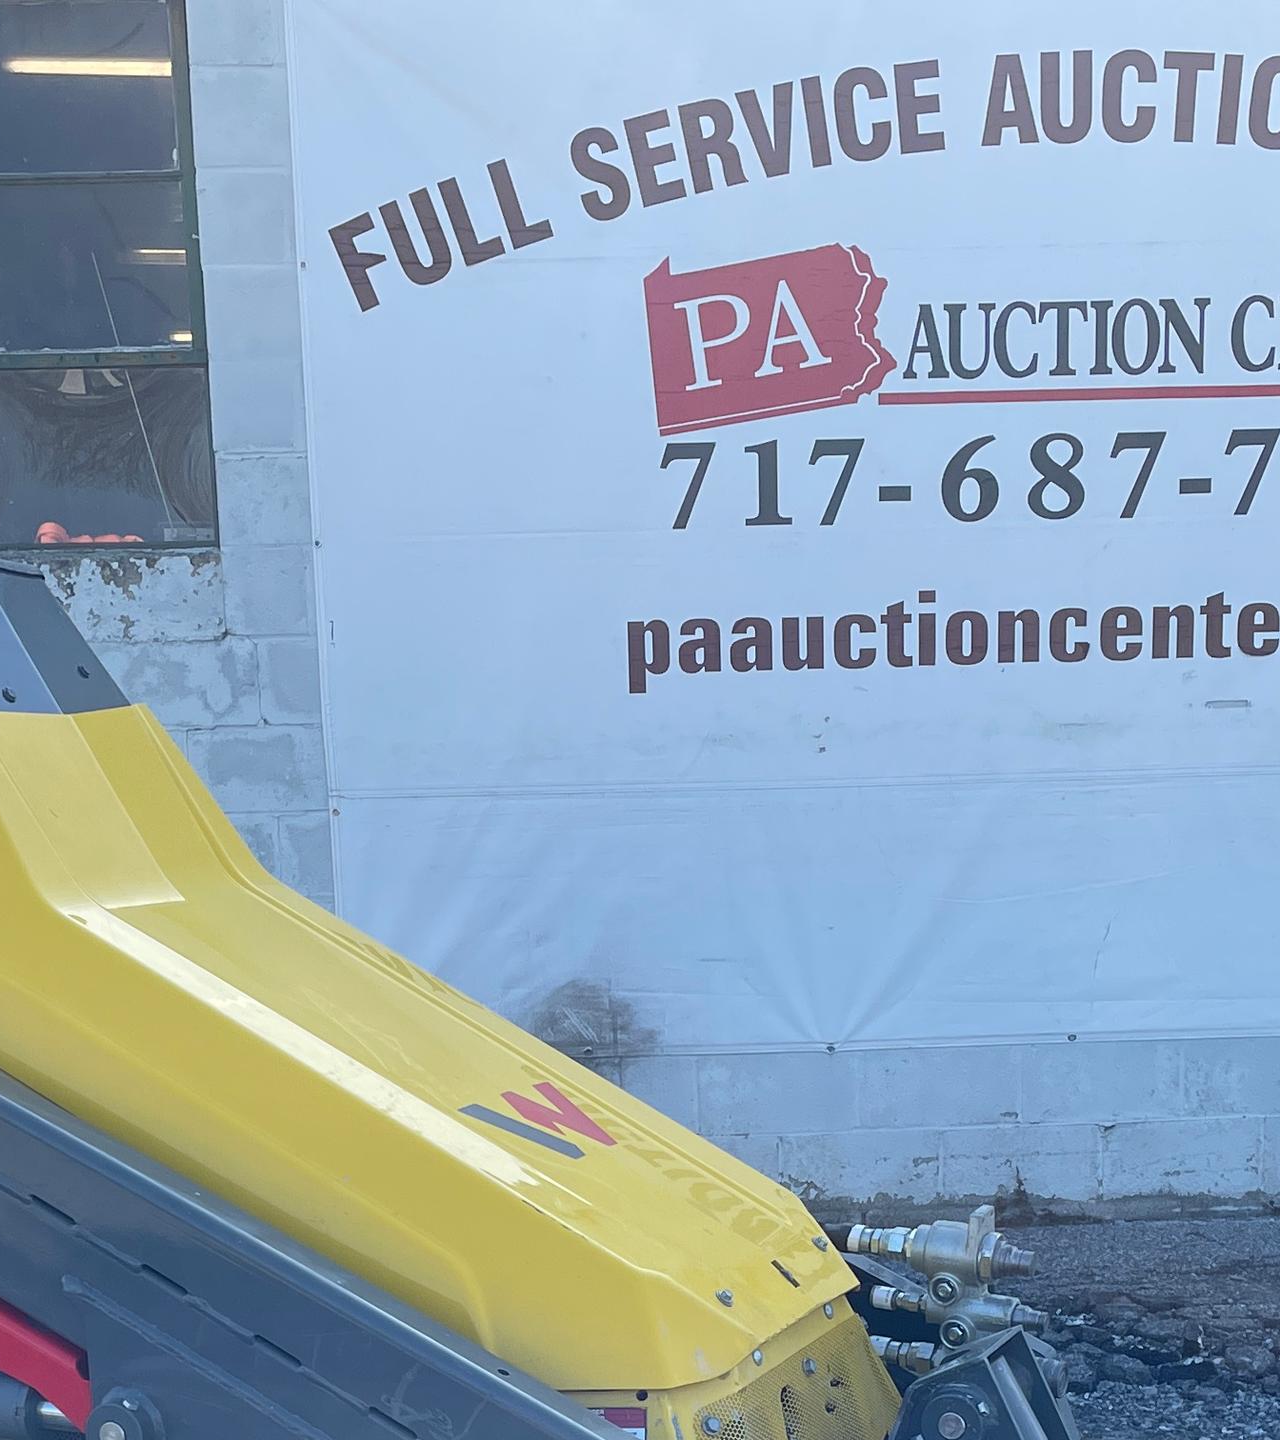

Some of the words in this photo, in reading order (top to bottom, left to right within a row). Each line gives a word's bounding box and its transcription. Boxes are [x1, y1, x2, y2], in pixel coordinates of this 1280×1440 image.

[328, 159, 553, 313] FULL
[570, 60, 946, 222] SERVICE
[673, 280, 833, 392] PA
[902, 297, 1212, 380] AUCTION
